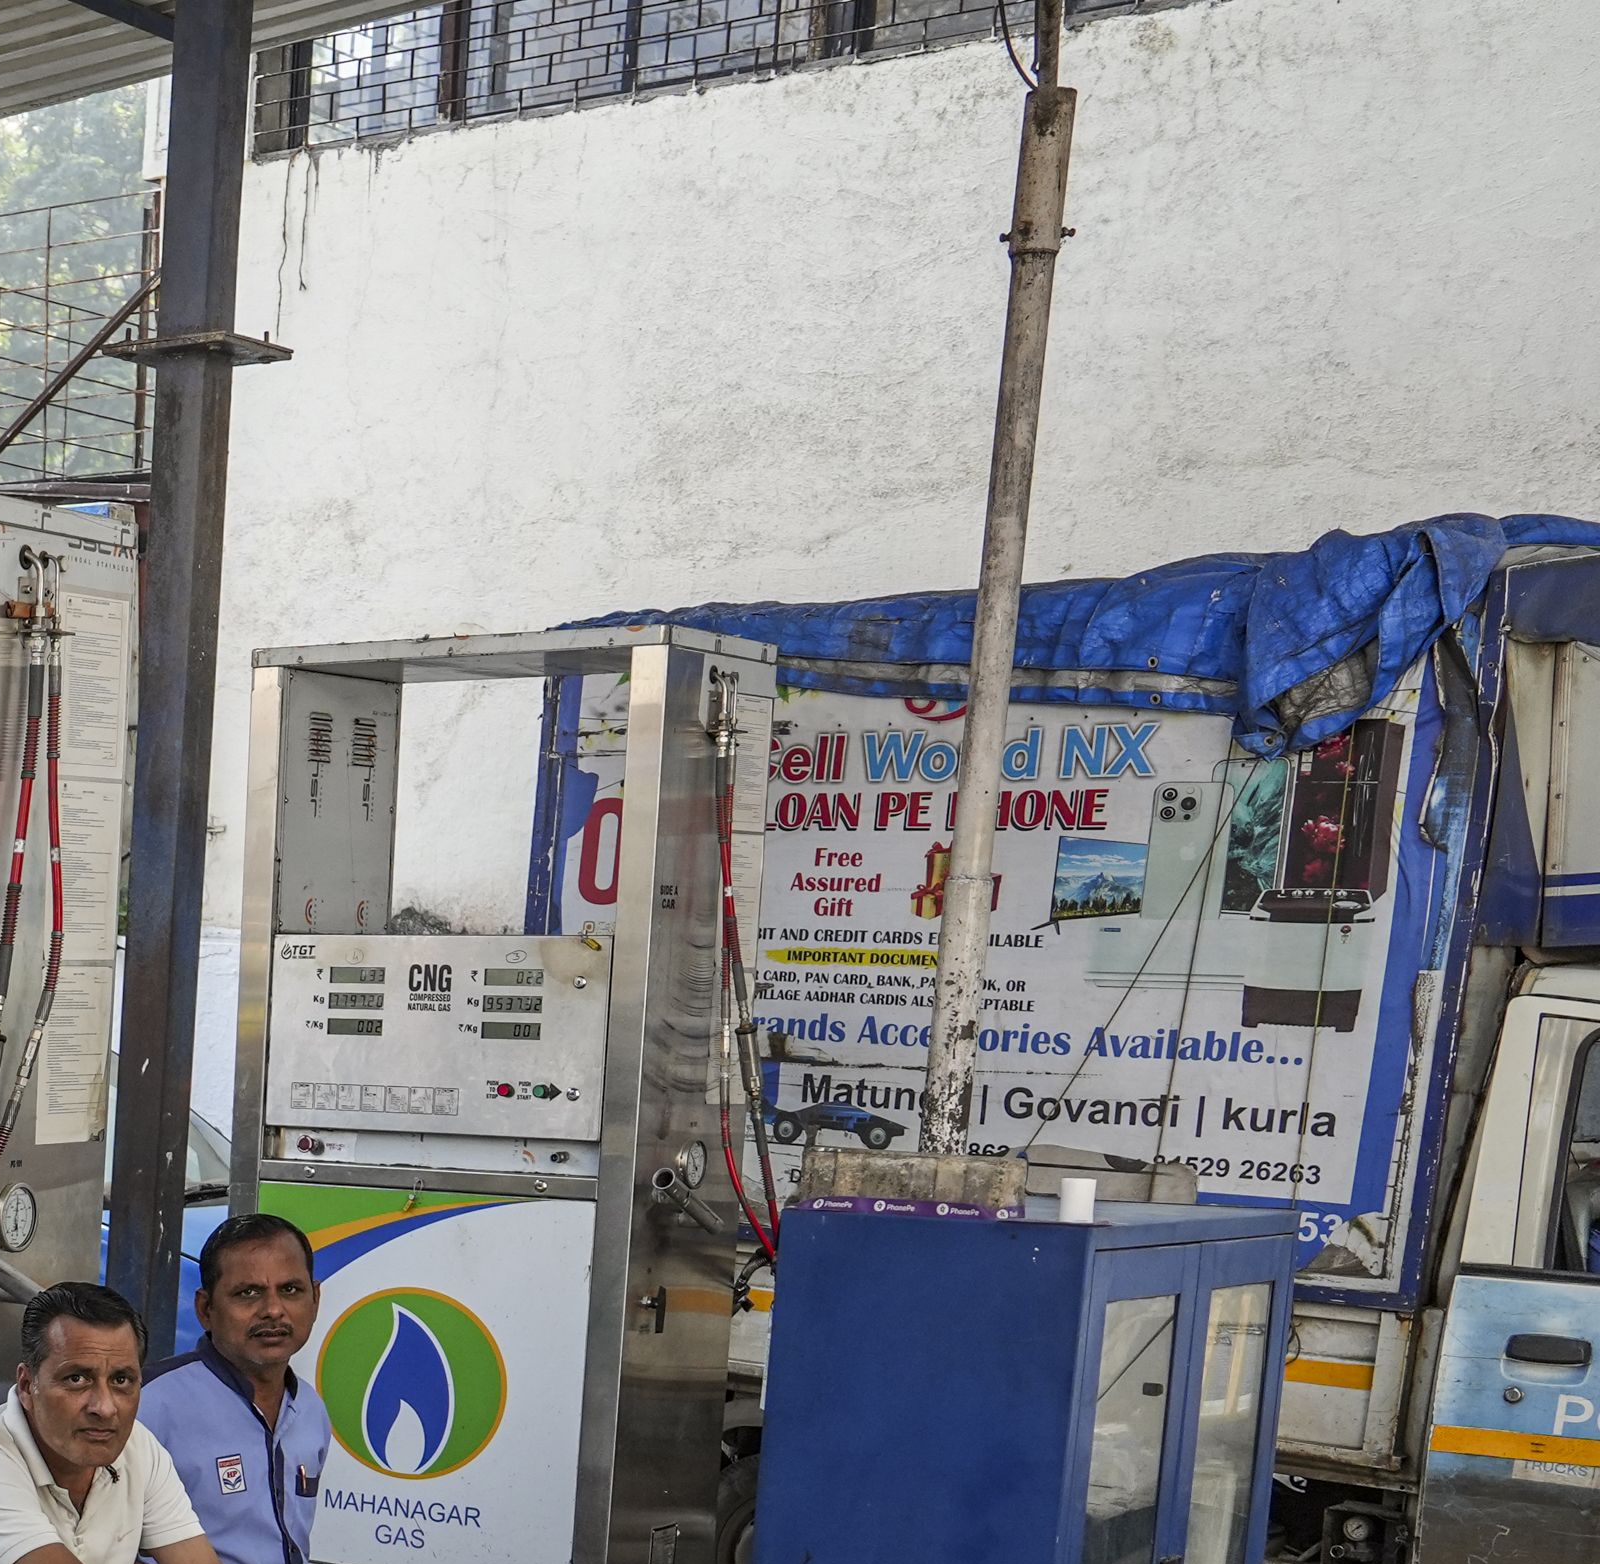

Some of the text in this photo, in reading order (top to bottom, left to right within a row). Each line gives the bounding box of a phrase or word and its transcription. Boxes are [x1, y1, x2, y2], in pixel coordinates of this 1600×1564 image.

[863, 726, 1043, 784] Wod
[1059, 720, 1162, 780] NX
[874, 790, 934, 833] PE
[814, 847, 864, 868] Free
[789, 872, 883, 894] Assured
[812, 896, 854, 918] Gift
[779, 927, 1045, 949] AND CREDIT CARDS ILABLE
[291, 944, 317, 956] TGT
[786, 950, 939, 967] IMPORTANT DOCUMEN
[359, 969, 385, 982] 033
[407, 963, 453, 993] CNG
[516, 971, 545, 985] 022
[804, 971, 829, 985] PAN
[1005, 979, 1026, 993] OR
[313, 994, 325, 1005] Kg
[409, 992, 452, 1003] COMPRESSED
[466, 997, 480, 1008] Kg
[803, 990, 856, 1005] AADHAR
[859, 992, 907, 1007] CARDIS
[407, 1002, 452, 1013] NATURAL GAS
[356, 1020, 383, 1034] 002
[856, 1014, 1072, 1057] Acceories
[801, 1072, 1337, 1139] Matun Govandi kurla
[1238, 1159, 1322, 1186] 26263
[823, 1199, 853, 1210] PhonePe
[886, 1203, 916, 1214] PhonePe
[949, 1206, 980, 1217] PhonePe
[1552, 1393, 1600, 1436] P
[226, 1470, 238, 1479] HP
[323, 1488, 482, 1529] MAHANAGAR
[374, 1523, 426, 1549] GAS
